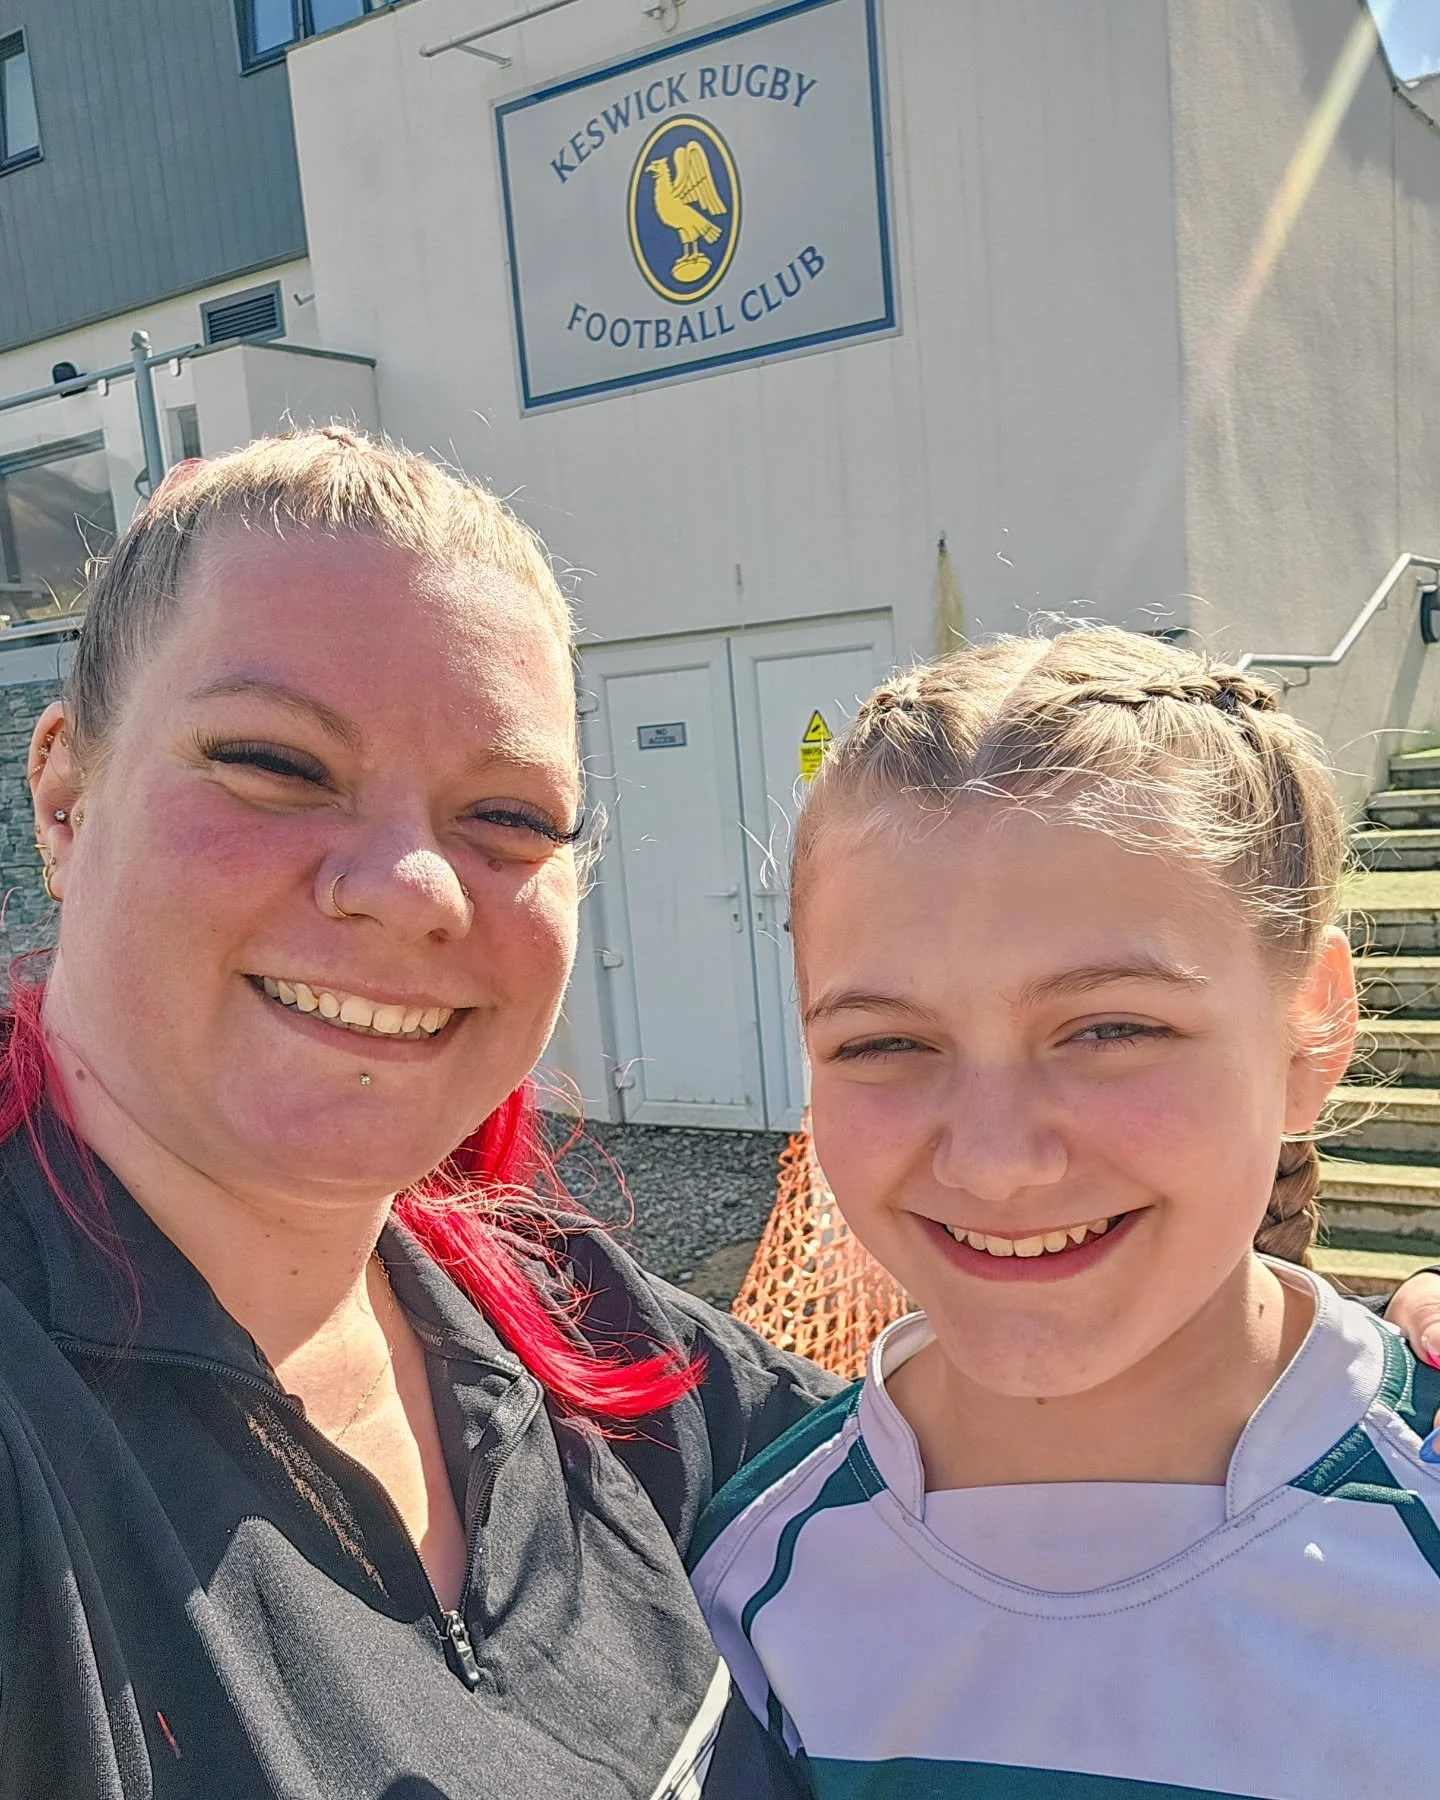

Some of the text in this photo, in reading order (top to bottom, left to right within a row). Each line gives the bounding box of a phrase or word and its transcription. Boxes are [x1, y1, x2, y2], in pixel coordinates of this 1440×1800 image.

[551, 64, 817, 183] KESWICK RUGBY
[567, 246, 825, 348] FOOTBALL CLUB
